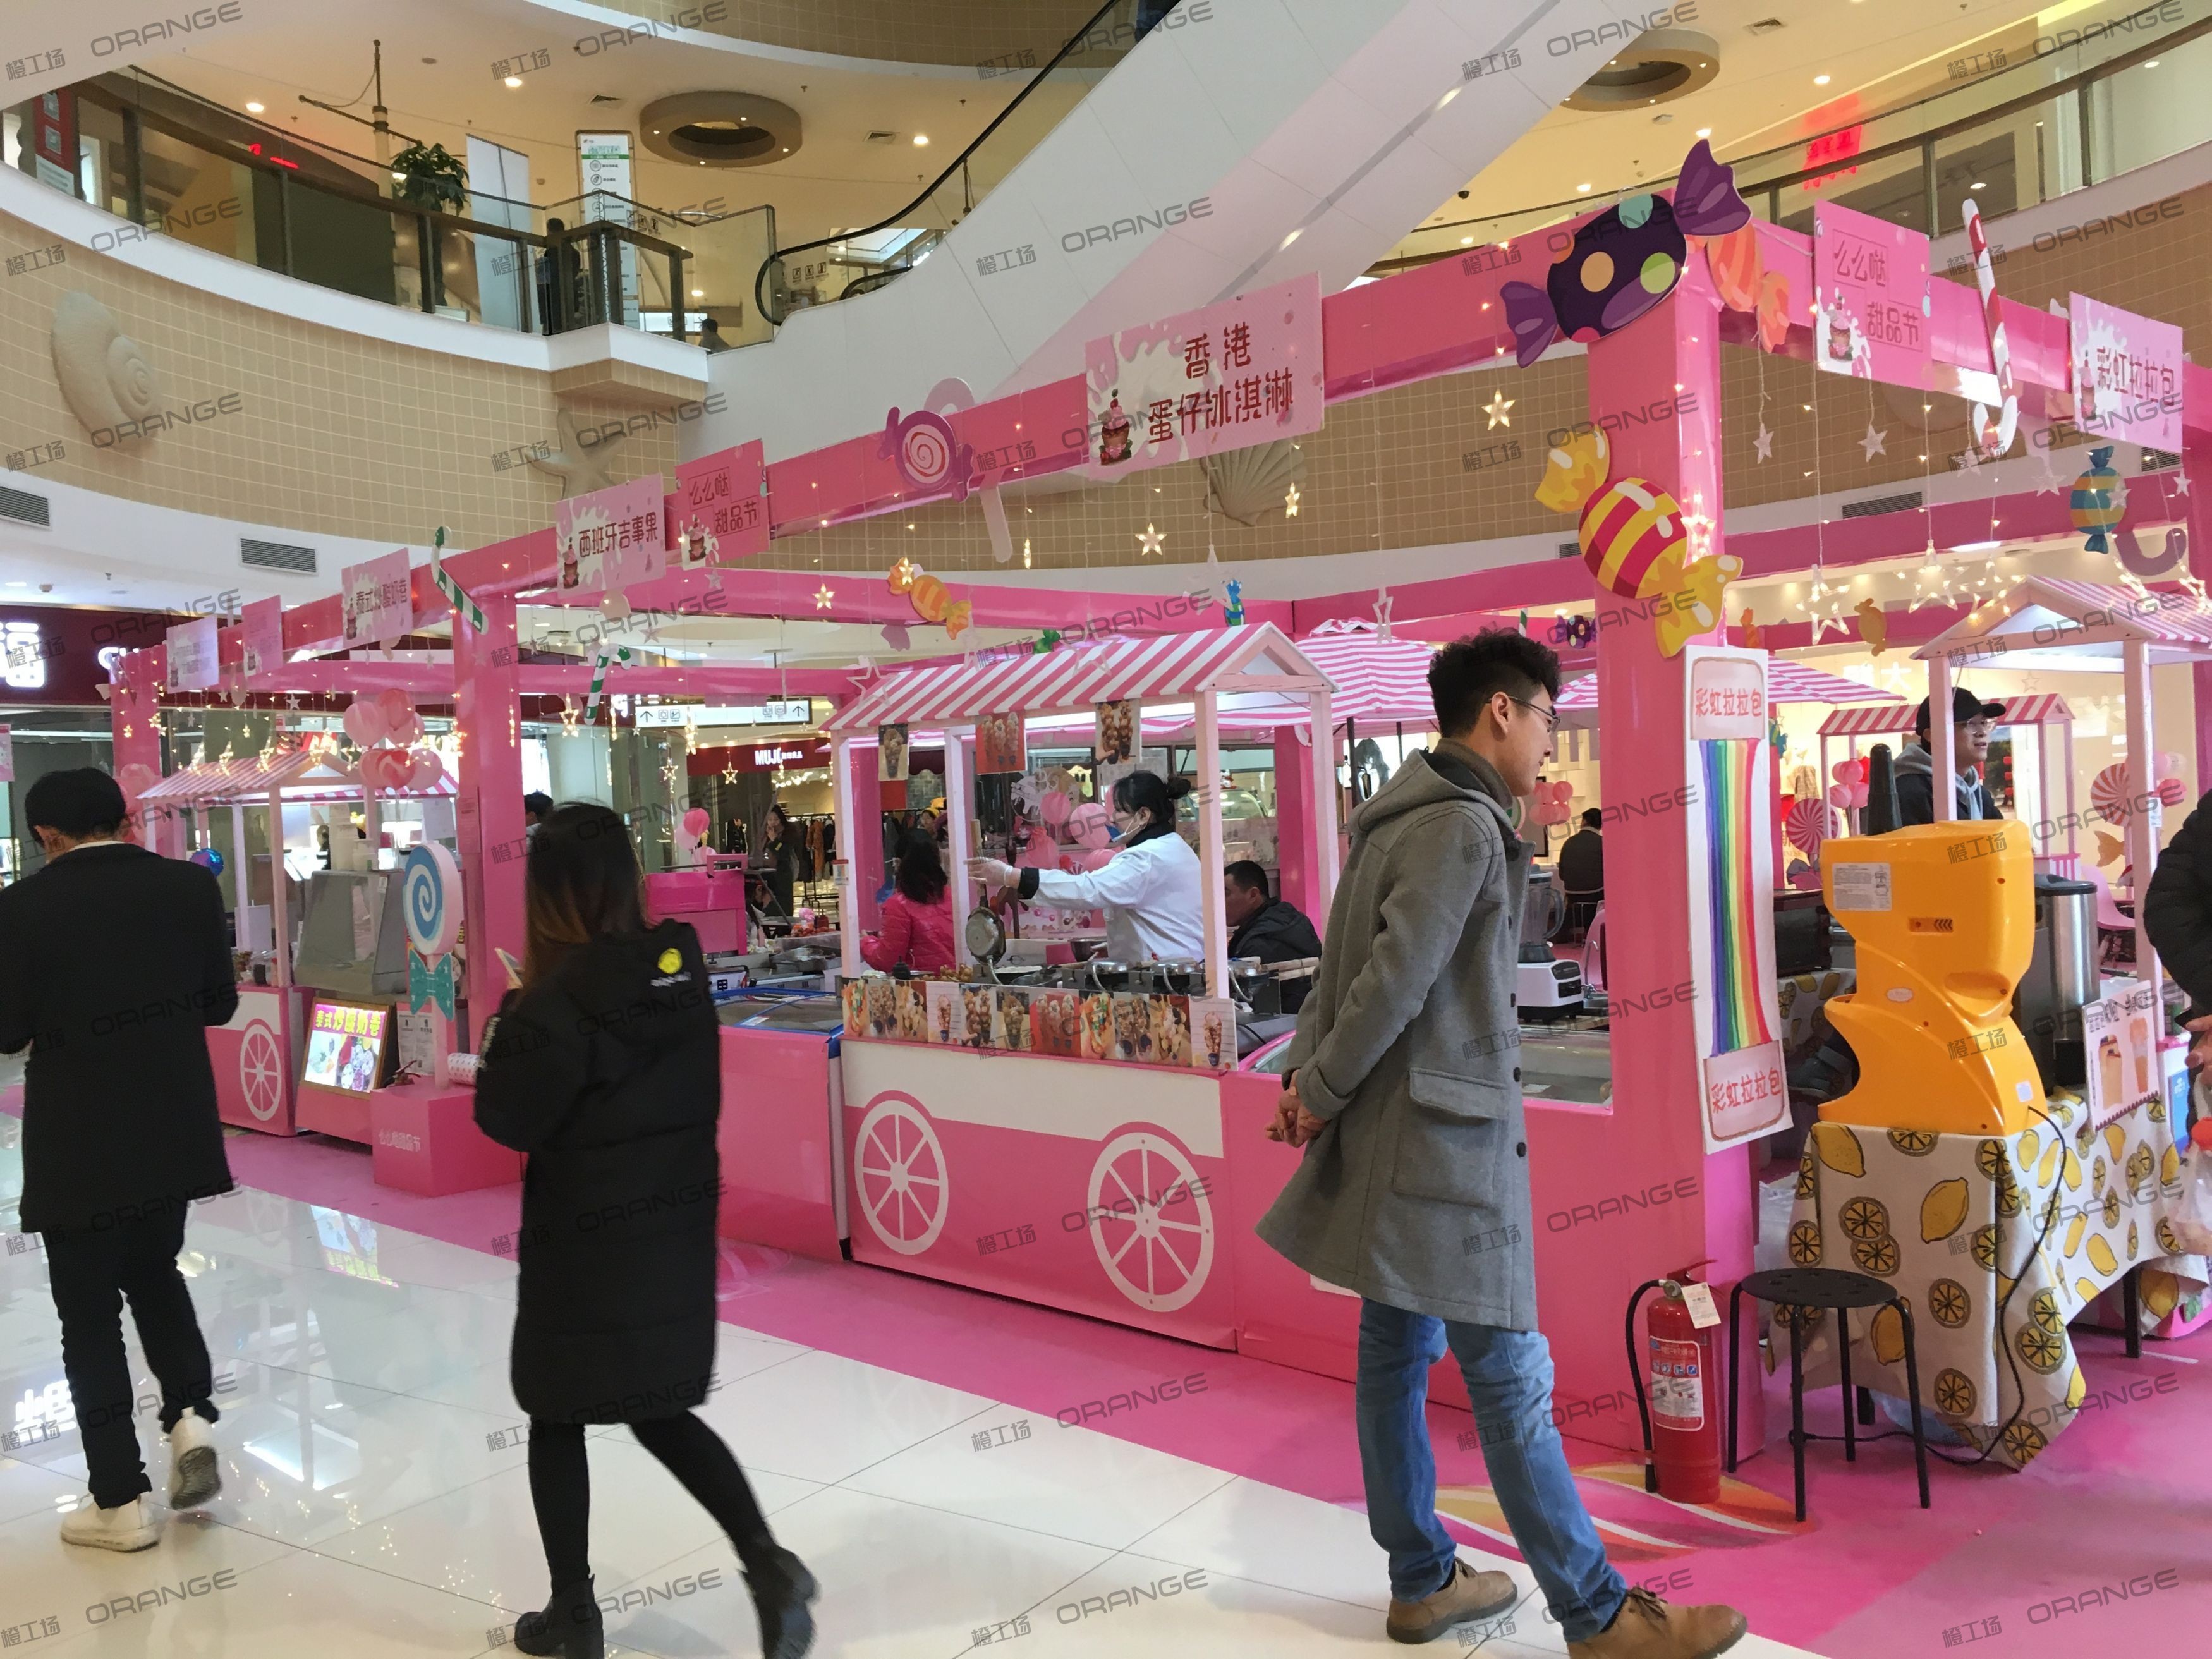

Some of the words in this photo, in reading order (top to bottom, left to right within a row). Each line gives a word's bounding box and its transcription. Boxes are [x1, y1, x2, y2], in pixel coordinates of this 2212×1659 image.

[1834, 240, 1887, 287] 么么哒
[1867, 302, 1919, 346] 甜品节
[1184, 322, 1251, 379] 香港
[2097, 346, 2175, 406] 彩虹拉拉包
[1148, 367, 1294, 444] 蛋仔冰淇淋
[690, 473, 729, 506] 么么哒
[578, 512, 658, 558] 西班牙吉事果
[715, 501, 758, 535] 甜品节
[1695, 688, 1762, 717] 彩虹拉拉包
[755, 749, 781, 765] MUJI
[1711, 1067, 1782, 1114] 彩虹拉拉包
